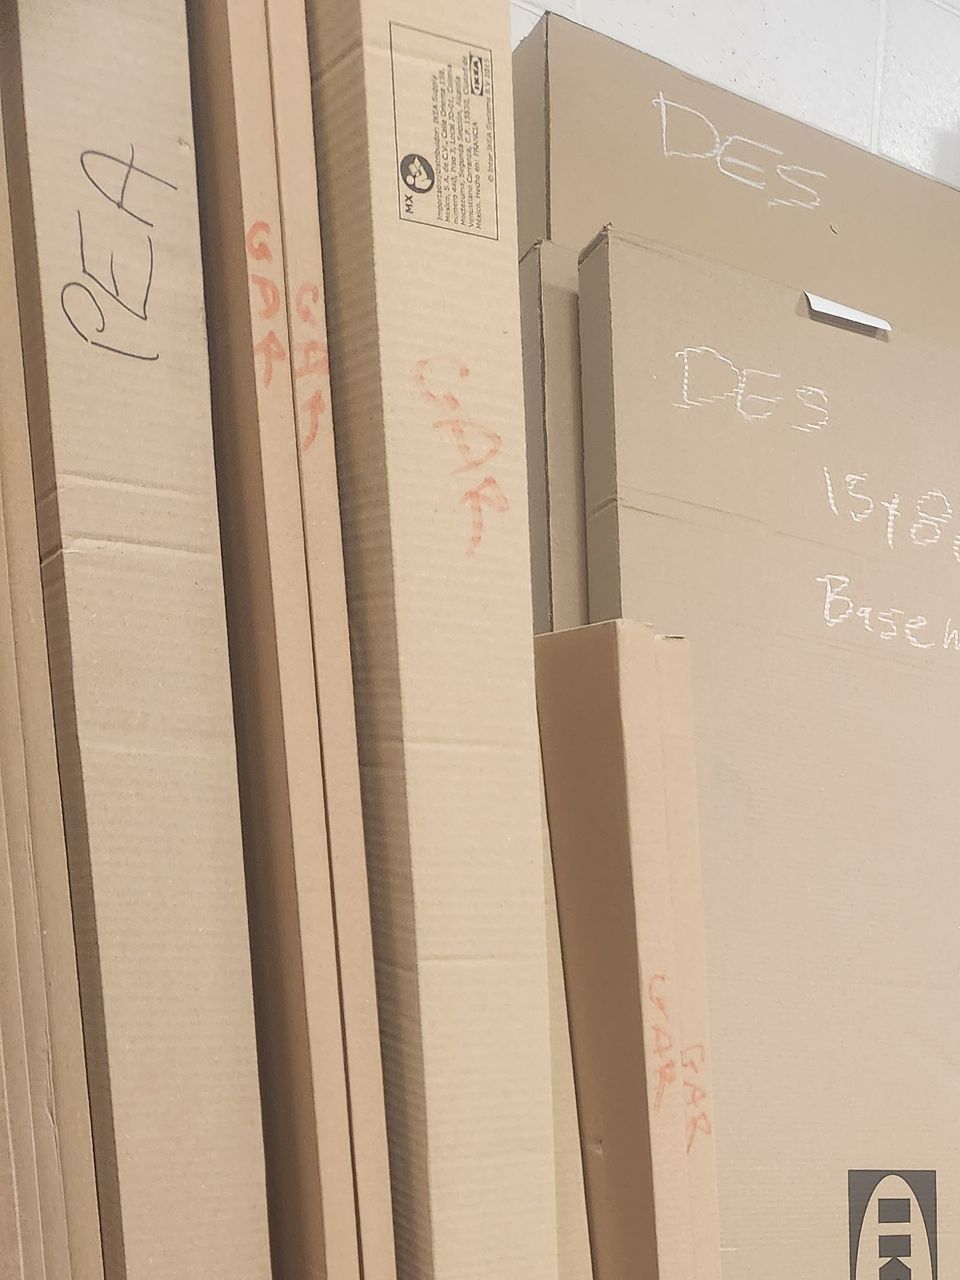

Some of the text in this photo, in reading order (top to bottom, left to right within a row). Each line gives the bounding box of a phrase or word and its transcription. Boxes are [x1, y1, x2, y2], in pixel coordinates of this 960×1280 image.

[650, 90, 827, 210] DES
[405, 193, 413, 214] MX
[673, 345, 831, 434] DES
